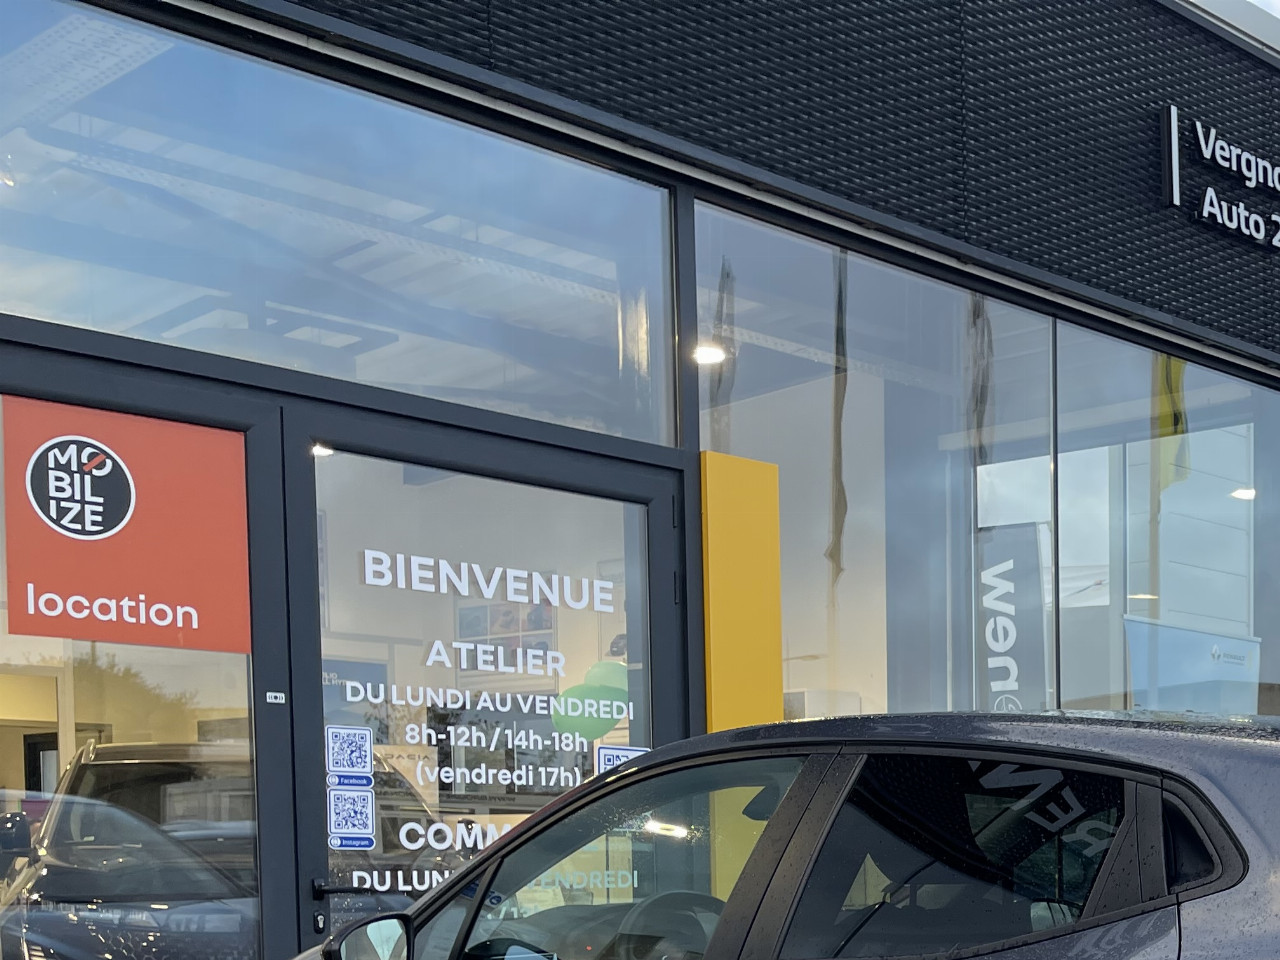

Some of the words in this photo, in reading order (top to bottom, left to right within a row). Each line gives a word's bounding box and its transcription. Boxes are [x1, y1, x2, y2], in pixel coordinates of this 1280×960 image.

[1202, 186, 1266, 240] Auto
[48, 469, 104, 504] BIL
[49, 499, 104, 532] IZE
[364, 548, 615, 613] BIENVENUE
[27, 582, 199, 630] location
[425, 639, 567, 677] ATELIER
[345, 680, 385, 704] DU
[391, 684, 471, 710] LUNDI
[476, 690, 512, 713] AU
[516, 693, 634, 721] VENDREDI
[405, 723, 487, 748] 8h-12h
[504, 728, 588, 753] 14h-18h
[340, 777, 367, 785] Facebook
[416, 760, 534, 787] (vendredi
[538, 765, 582, 788] 17h)
[342, 838, 369, 847] Instagram
[352, 870, 391, 892] DU
[397, 870, 456, 892] LUN
